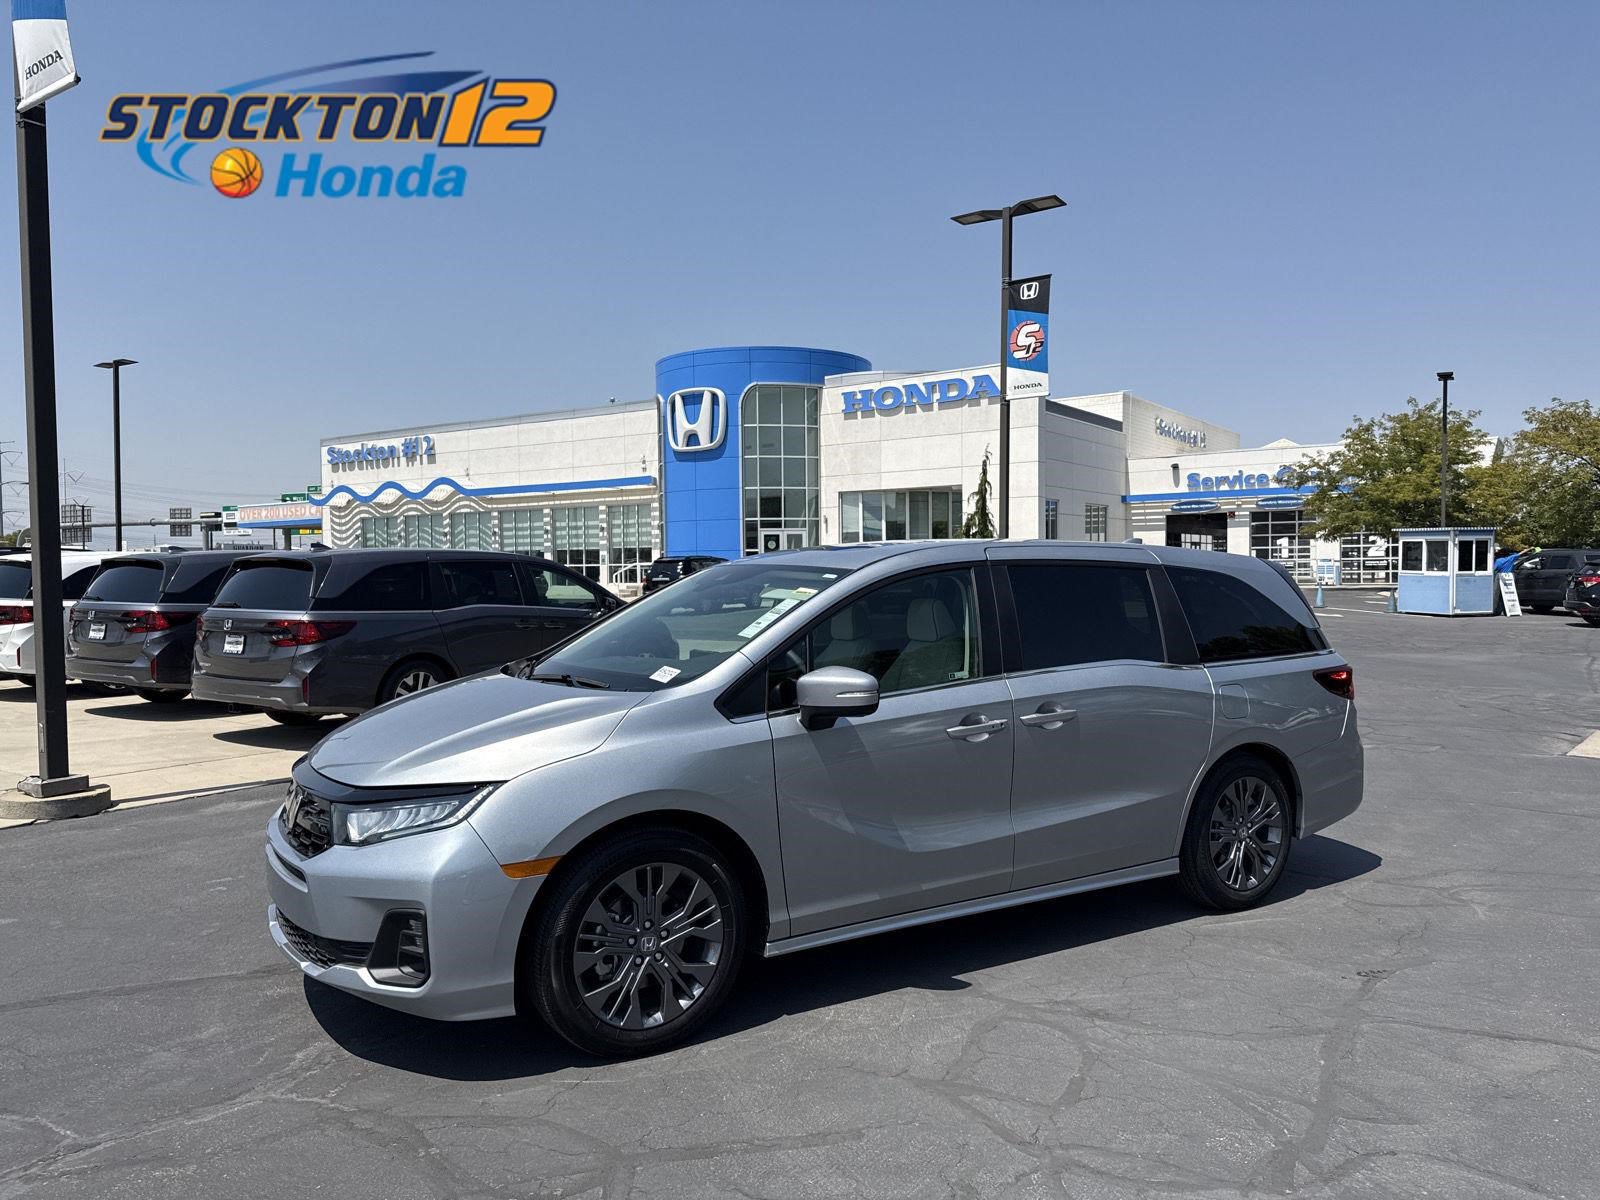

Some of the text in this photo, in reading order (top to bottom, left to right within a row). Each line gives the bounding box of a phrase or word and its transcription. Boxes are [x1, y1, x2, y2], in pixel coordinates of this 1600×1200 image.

[24, 49, 64, 80] HONDA
[841, 374, 1000, 414] HONDA
[1013, 382, 1043, 391] HONDA
[326, 435, 433, 465] Stockton #12
[1186, 469, 1271, 490] Service
[240, 504, 322, 520] OVER 200 USED CA
[1276, 537, 1289, 558] 1
[1367, 535, 1387, 557] 2
